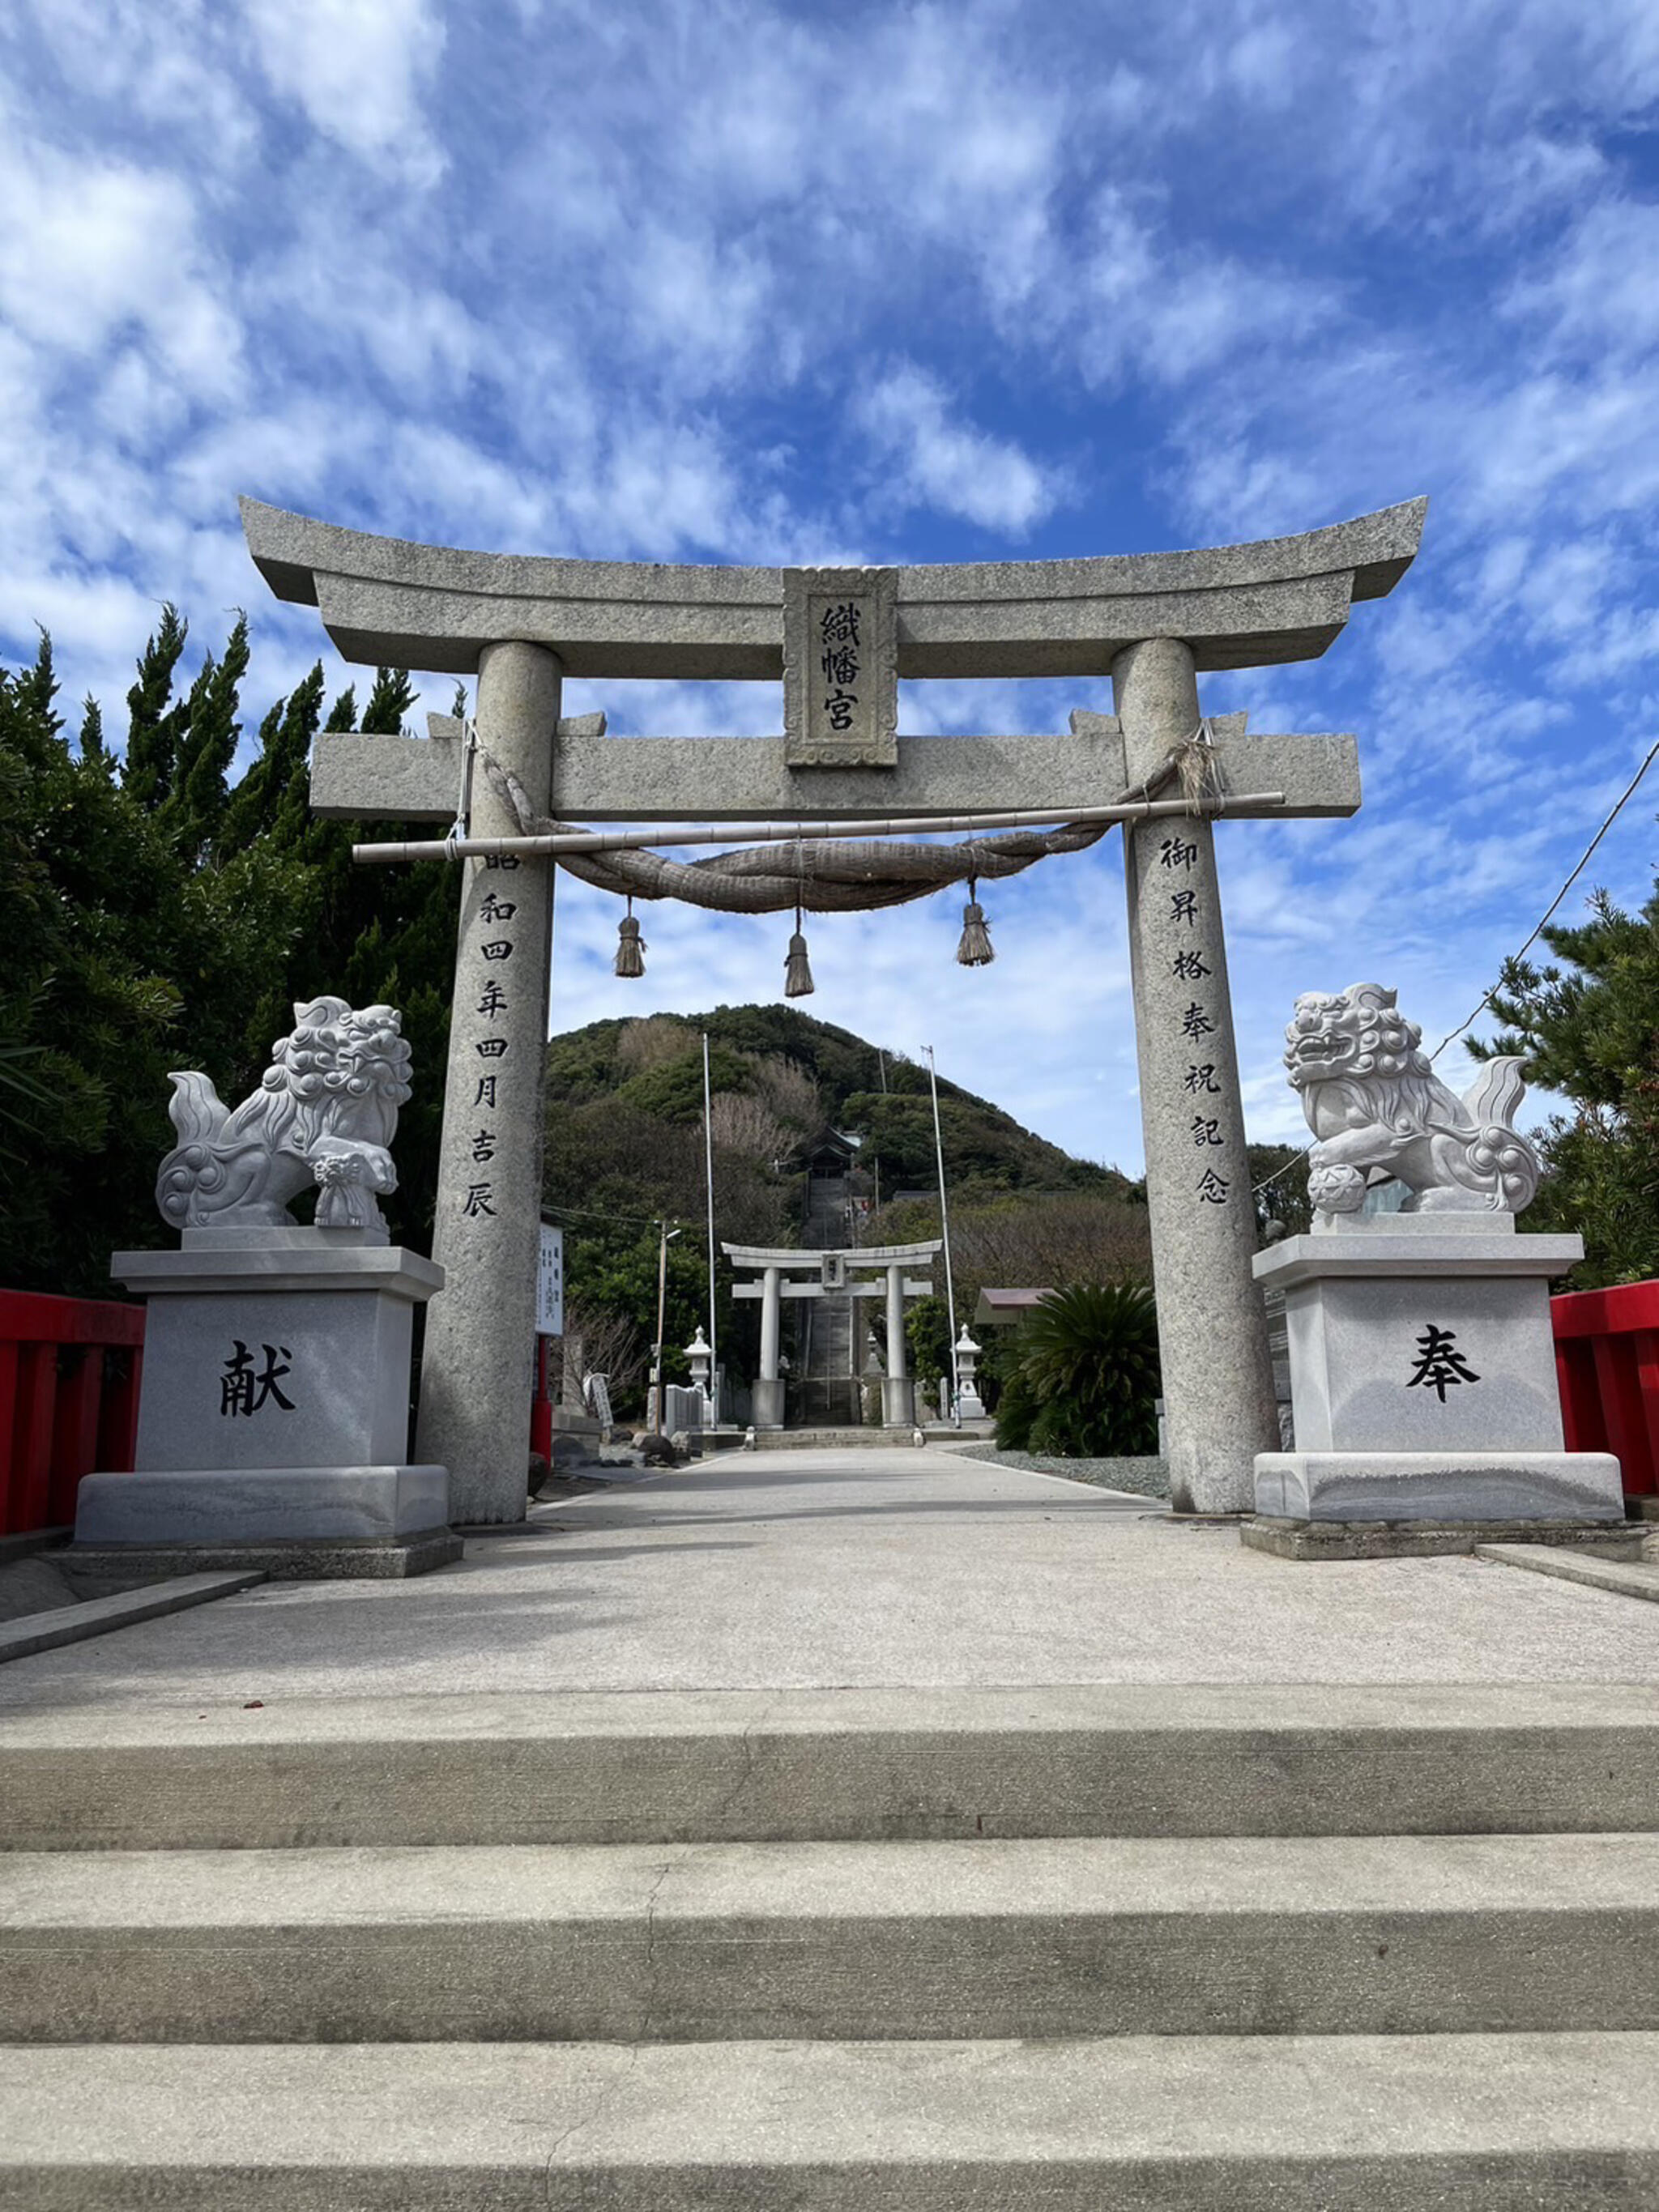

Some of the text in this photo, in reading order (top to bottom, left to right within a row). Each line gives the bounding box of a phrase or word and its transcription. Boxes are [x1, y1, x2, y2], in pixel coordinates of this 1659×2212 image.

[820, 602, 862, 731] 織幡宮
[1160, 837, 1230, 1205] 御昇格奉祝記念
[220, 1340, 296, 1417] 献
[1405, 1323, 1482, 1404] 奉
